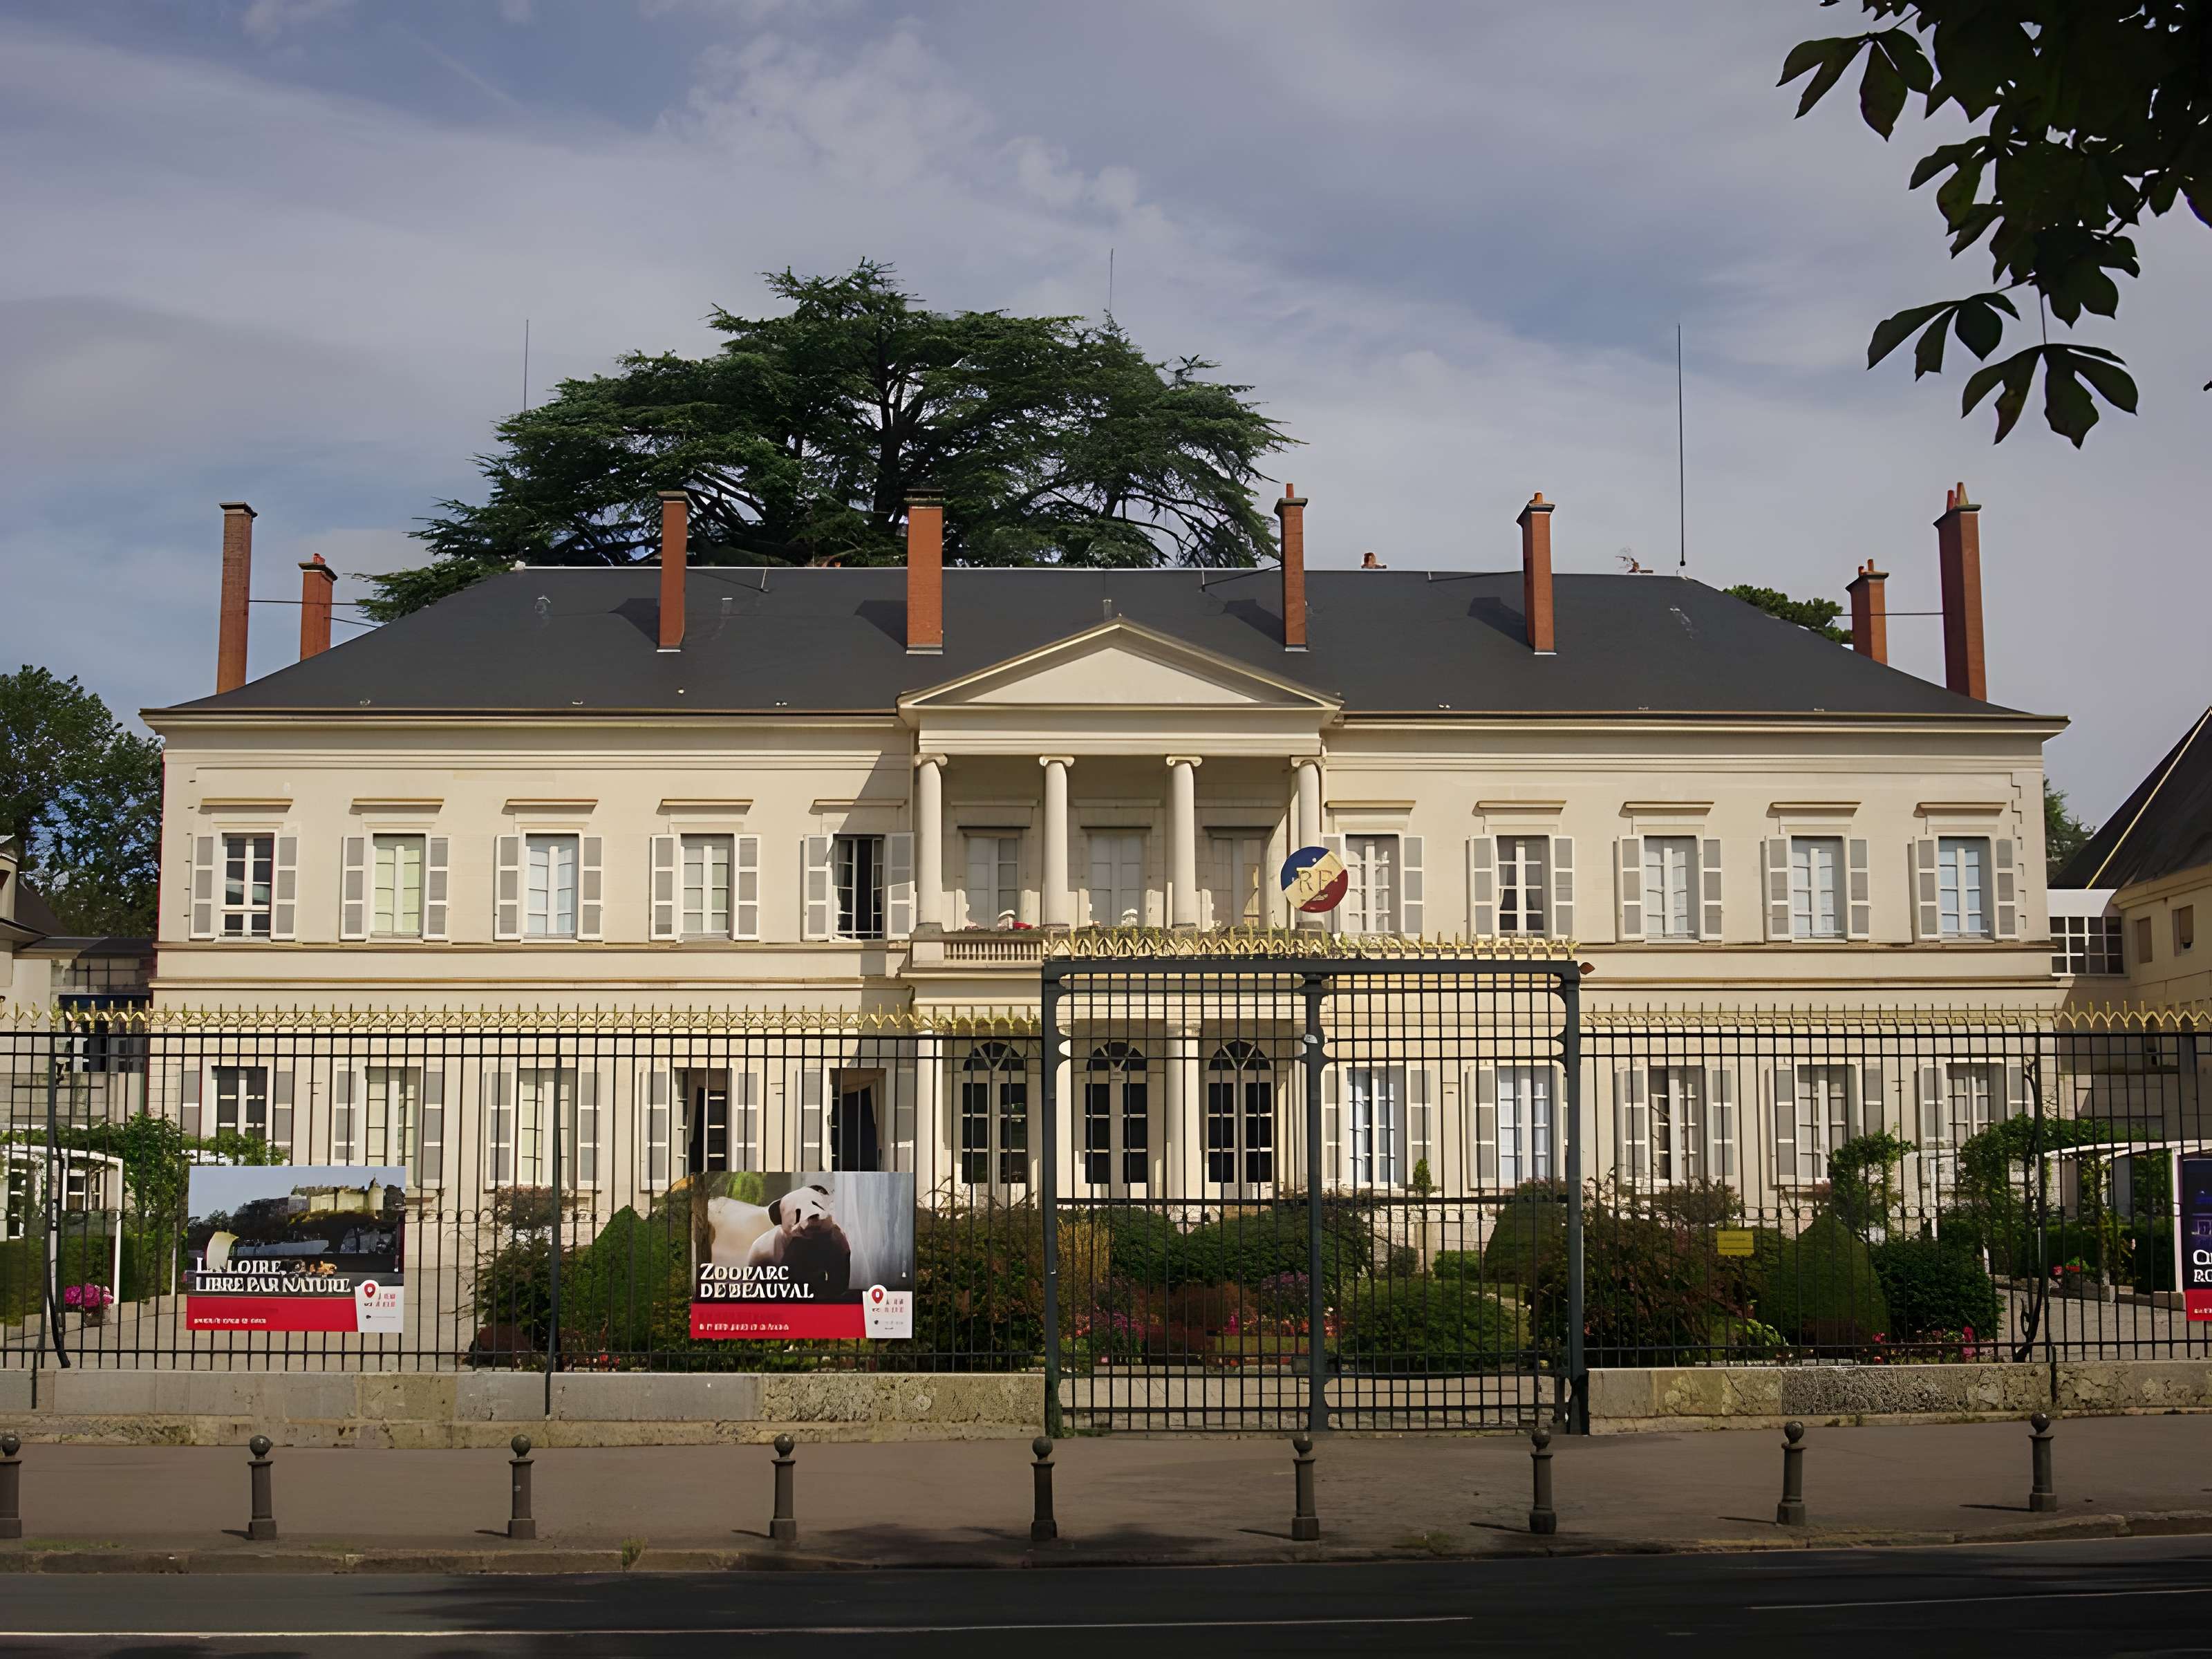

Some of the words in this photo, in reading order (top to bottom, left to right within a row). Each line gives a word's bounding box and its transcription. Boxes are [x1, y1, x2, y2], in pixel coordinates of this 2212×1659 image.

[700, 1263, 789, 1280] ZOOPARC
[196, 1276, 243, 1292] LIBRE
[729, 1282, 814, 1298] BEAUVAL
